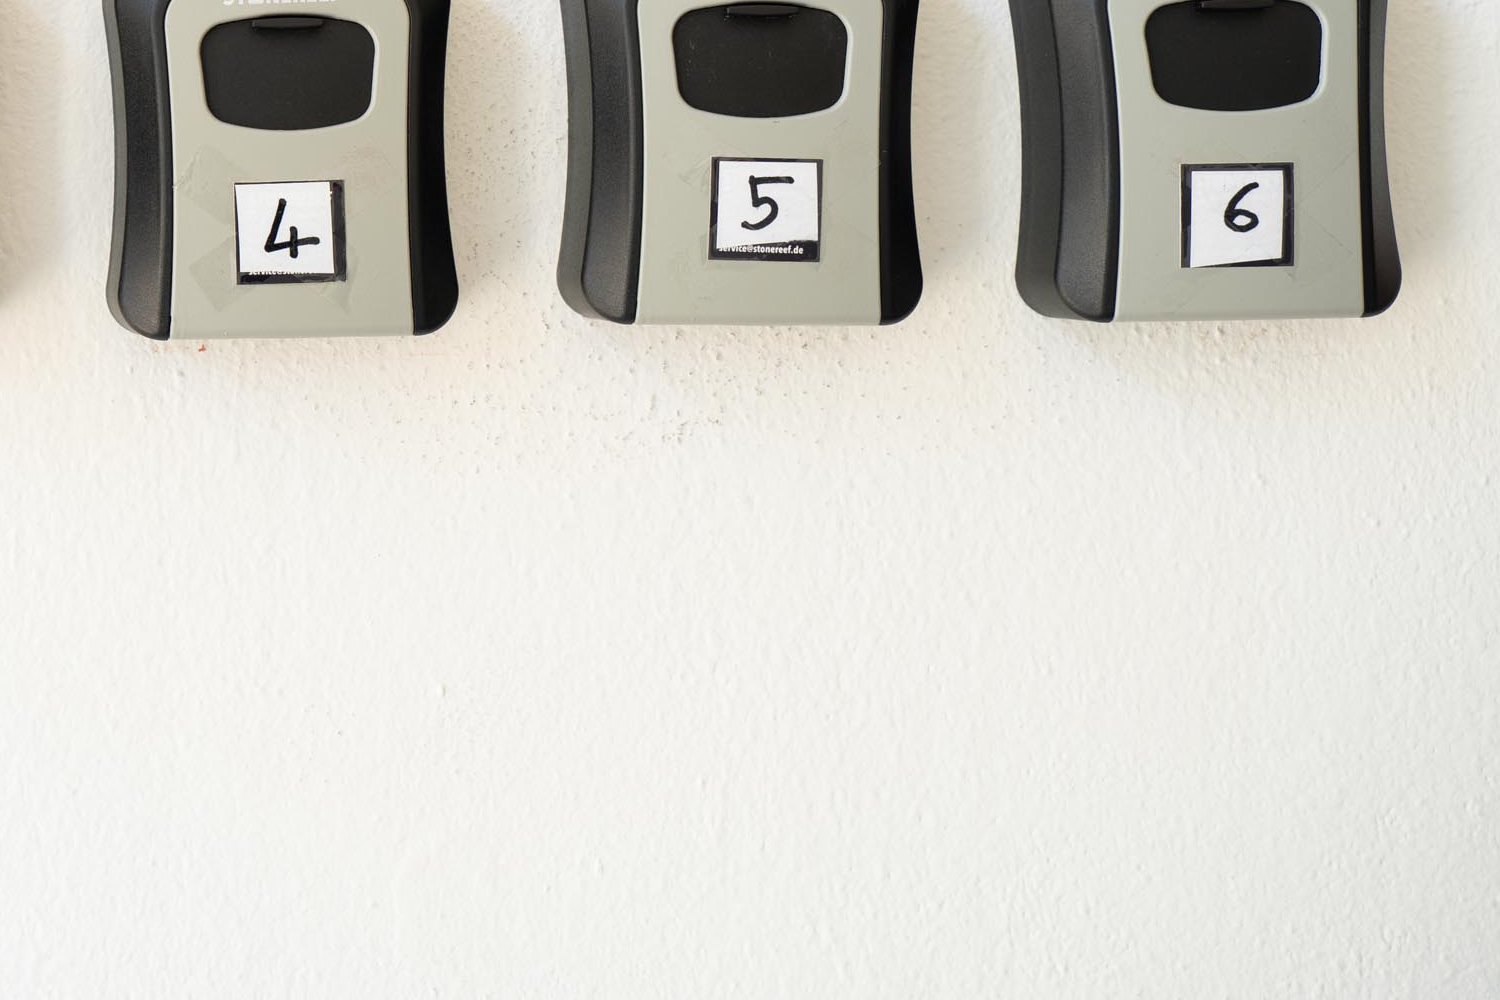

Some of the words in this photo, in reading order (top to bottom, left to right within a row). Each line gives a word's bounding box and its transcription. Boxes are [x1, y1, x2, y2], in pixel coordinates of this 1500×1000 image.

[264, 198, 320, 259] 4
[741, 175, 795, 231] 5
[1224, 182, 1259, 232] 6
